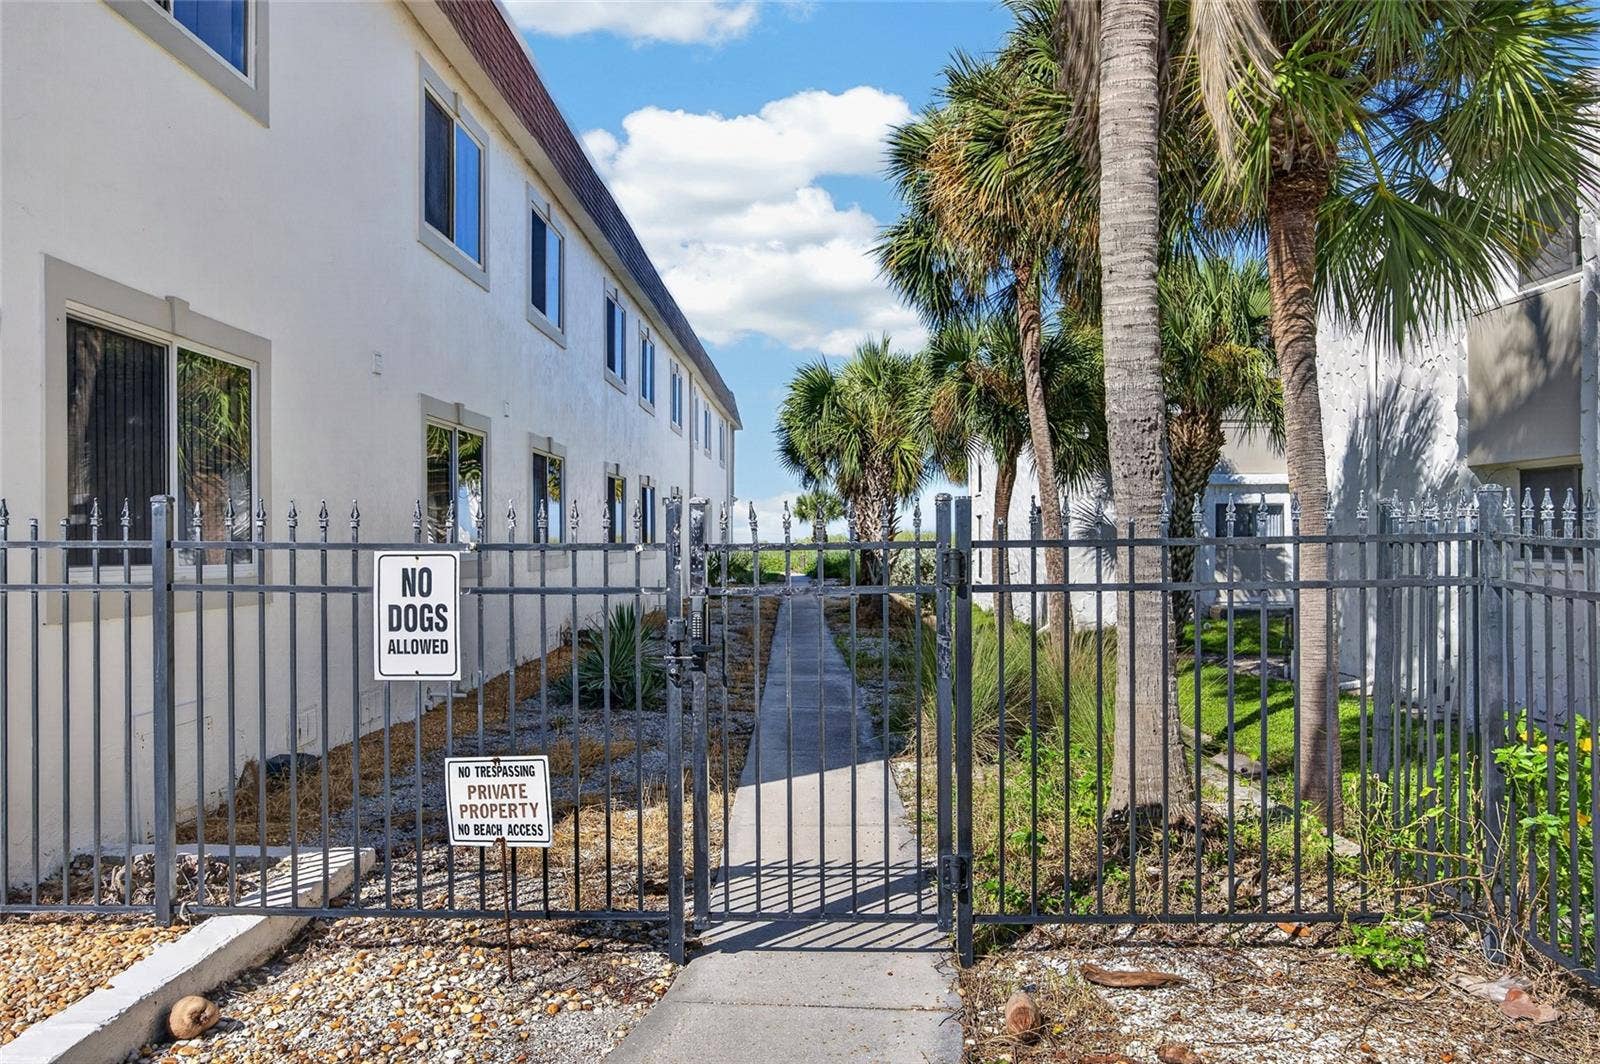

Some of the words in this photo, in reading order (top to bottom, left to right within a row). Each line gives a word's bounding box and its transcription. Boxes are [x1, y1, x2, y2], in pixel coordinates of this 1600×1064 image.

[402, 567, 432, 598] NO
[388, 604, 448, 632] DOGS
[388, 639, 448, 654] ALLOWED
[458, 766, 470, 778] NO
[475, 765, 535, 777] TRESPASSING
[468, 783, 528, 799] PRIVATE
[460, 802, 538, 819] PROPERTY
[458, 824, 470, 835] NO
[474, 824, 502, 835] BEACH
[507, 824, 543, 836] ACCESS
